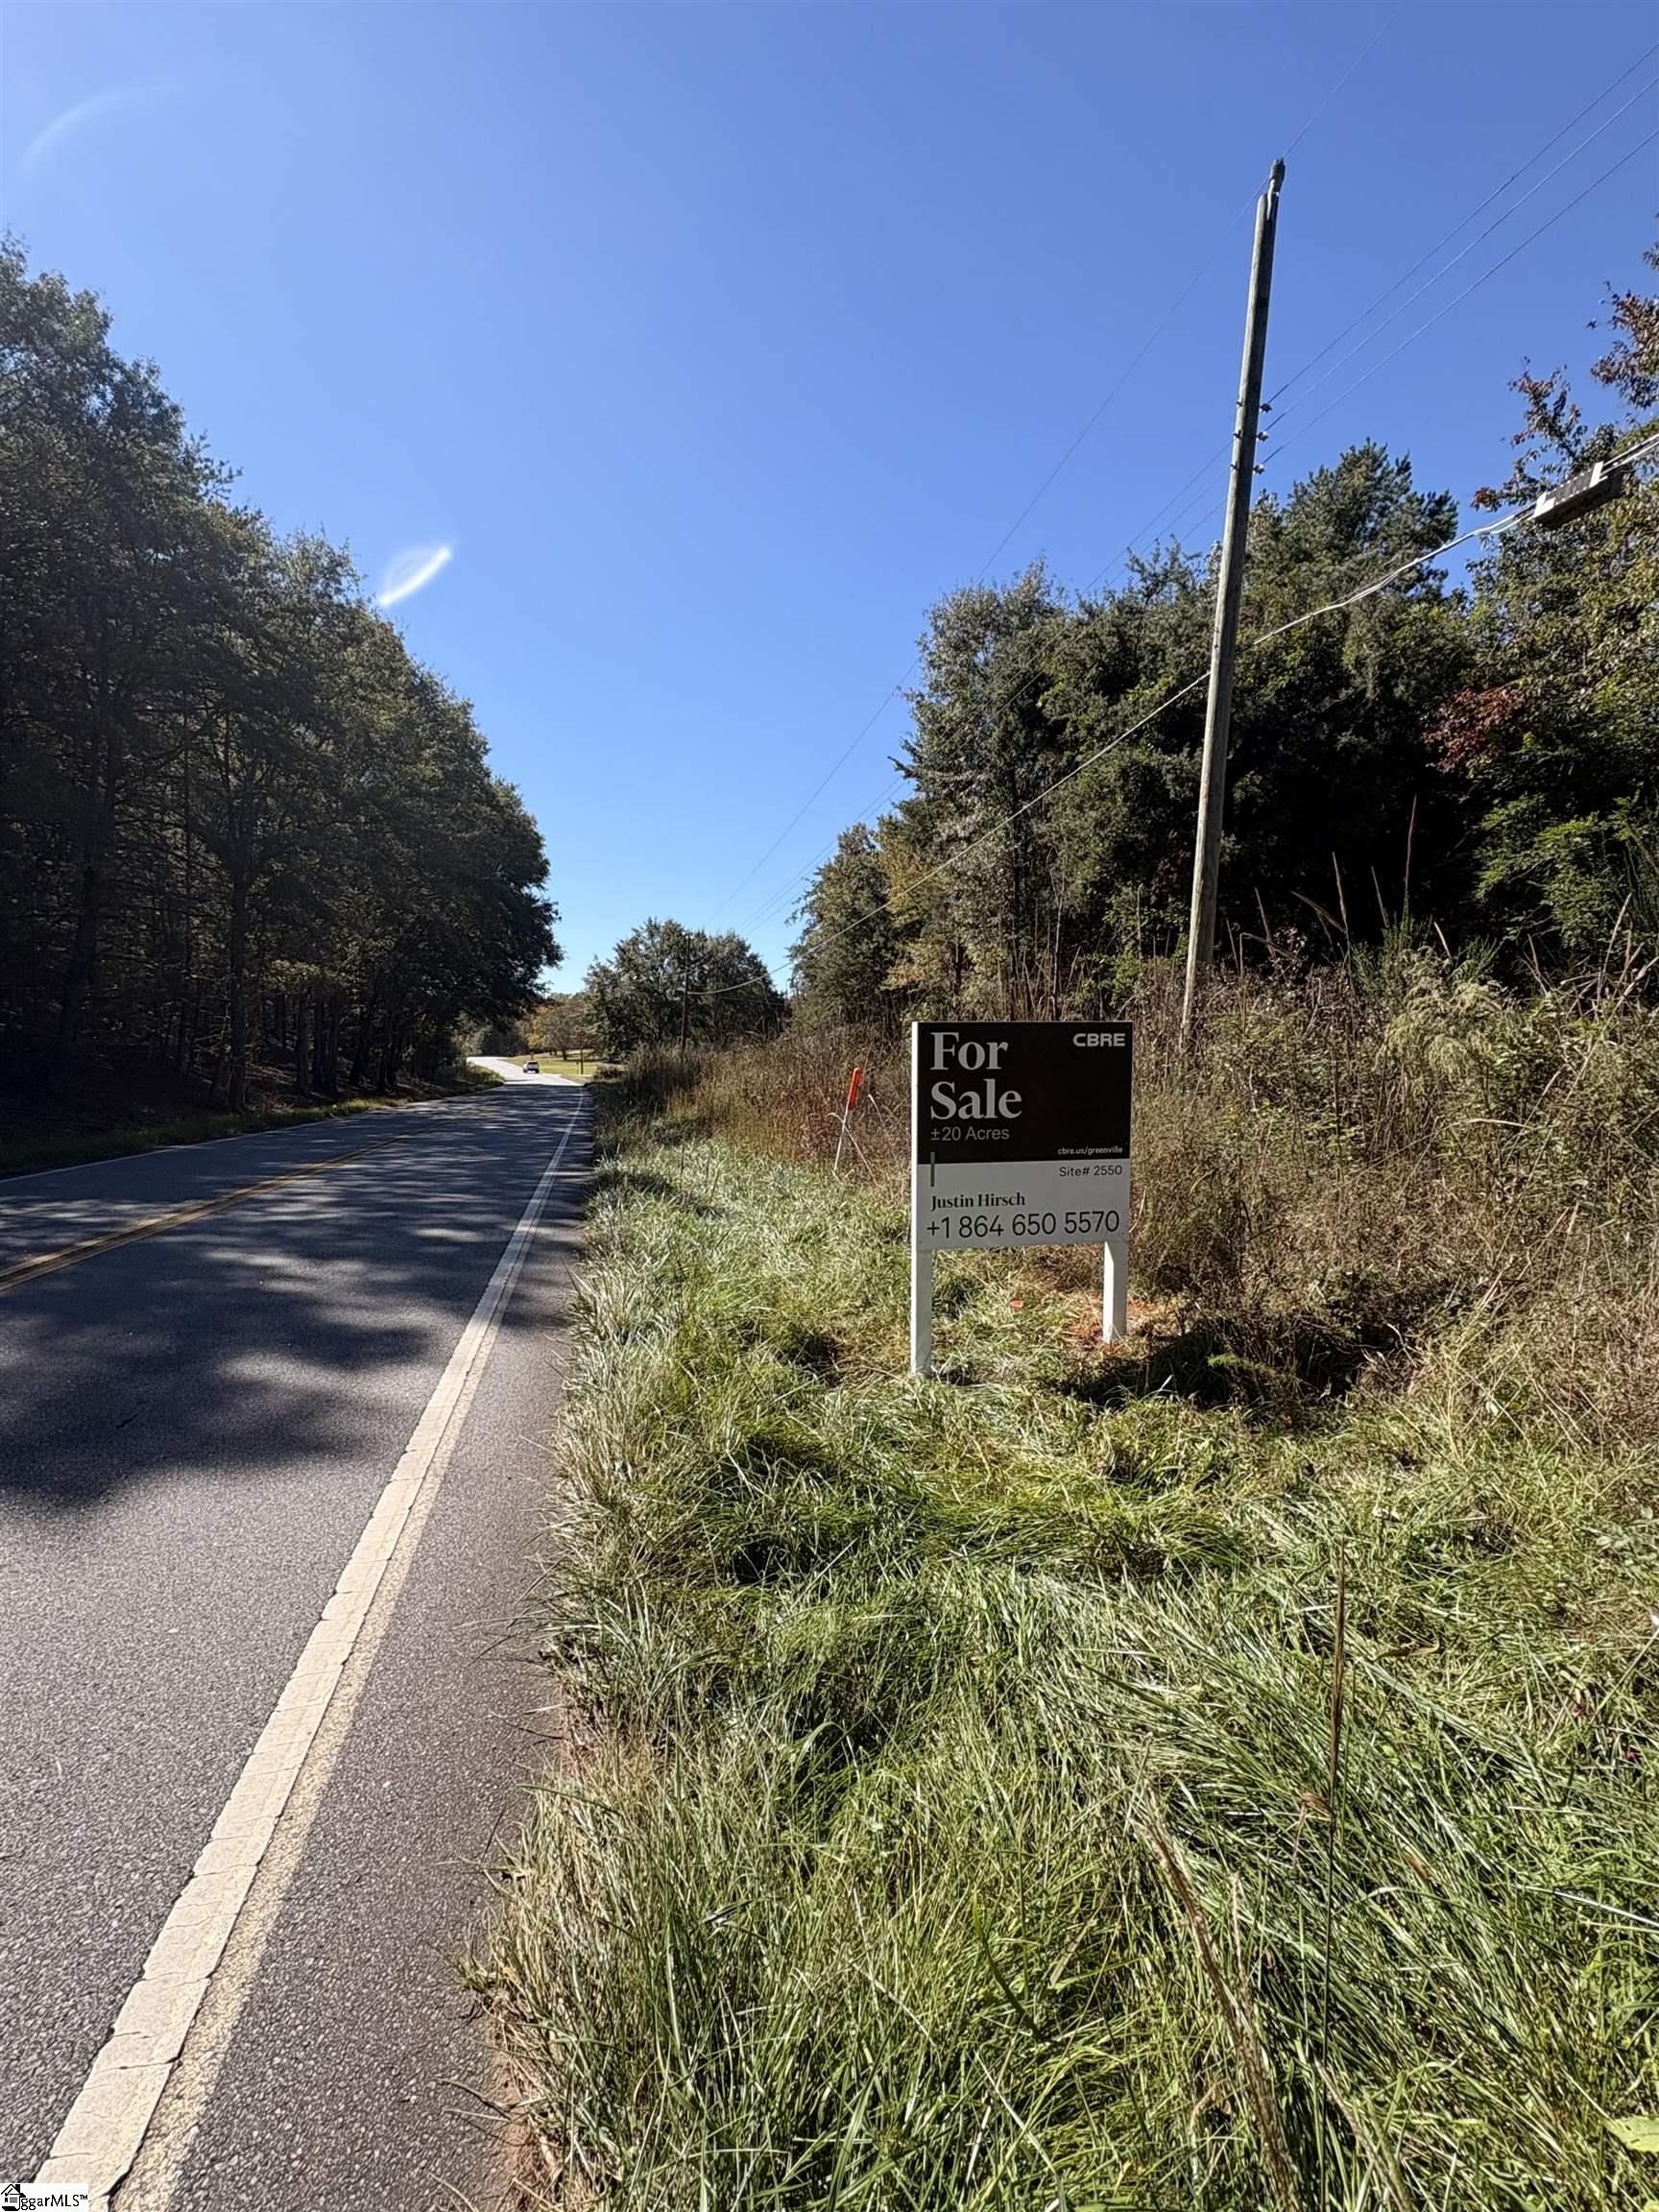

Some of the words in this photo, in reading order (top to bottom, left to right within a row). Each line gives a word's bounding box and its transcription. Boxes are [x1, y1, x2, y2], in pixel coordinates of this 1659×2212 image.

[1072, 1033, 1126, 1047] CBRE
[929, 1031, 1009, 1070] For
[930, 1078, 1022, 1120] Sale
[930, 1126, 962, 1142] ±20
[965, 1126, 1010, 1141] Acres
[1057, 1145, 1123, 1156] cbre.us/greenville
[1059, 1166, 1091, 1177] Site#
[1094, 1165, 1122, 1176] 2550
[930, 1194, 974, 1212] Justin
[977, 1192, 1025, 1208] Hirsch
[926, 1216, 950, 1238] +1
[958, 1214, 1004, 1238] 864
[1012, 1213, 1056, 1236] 650
[1064, 1210, 1120, 1234] 5570
